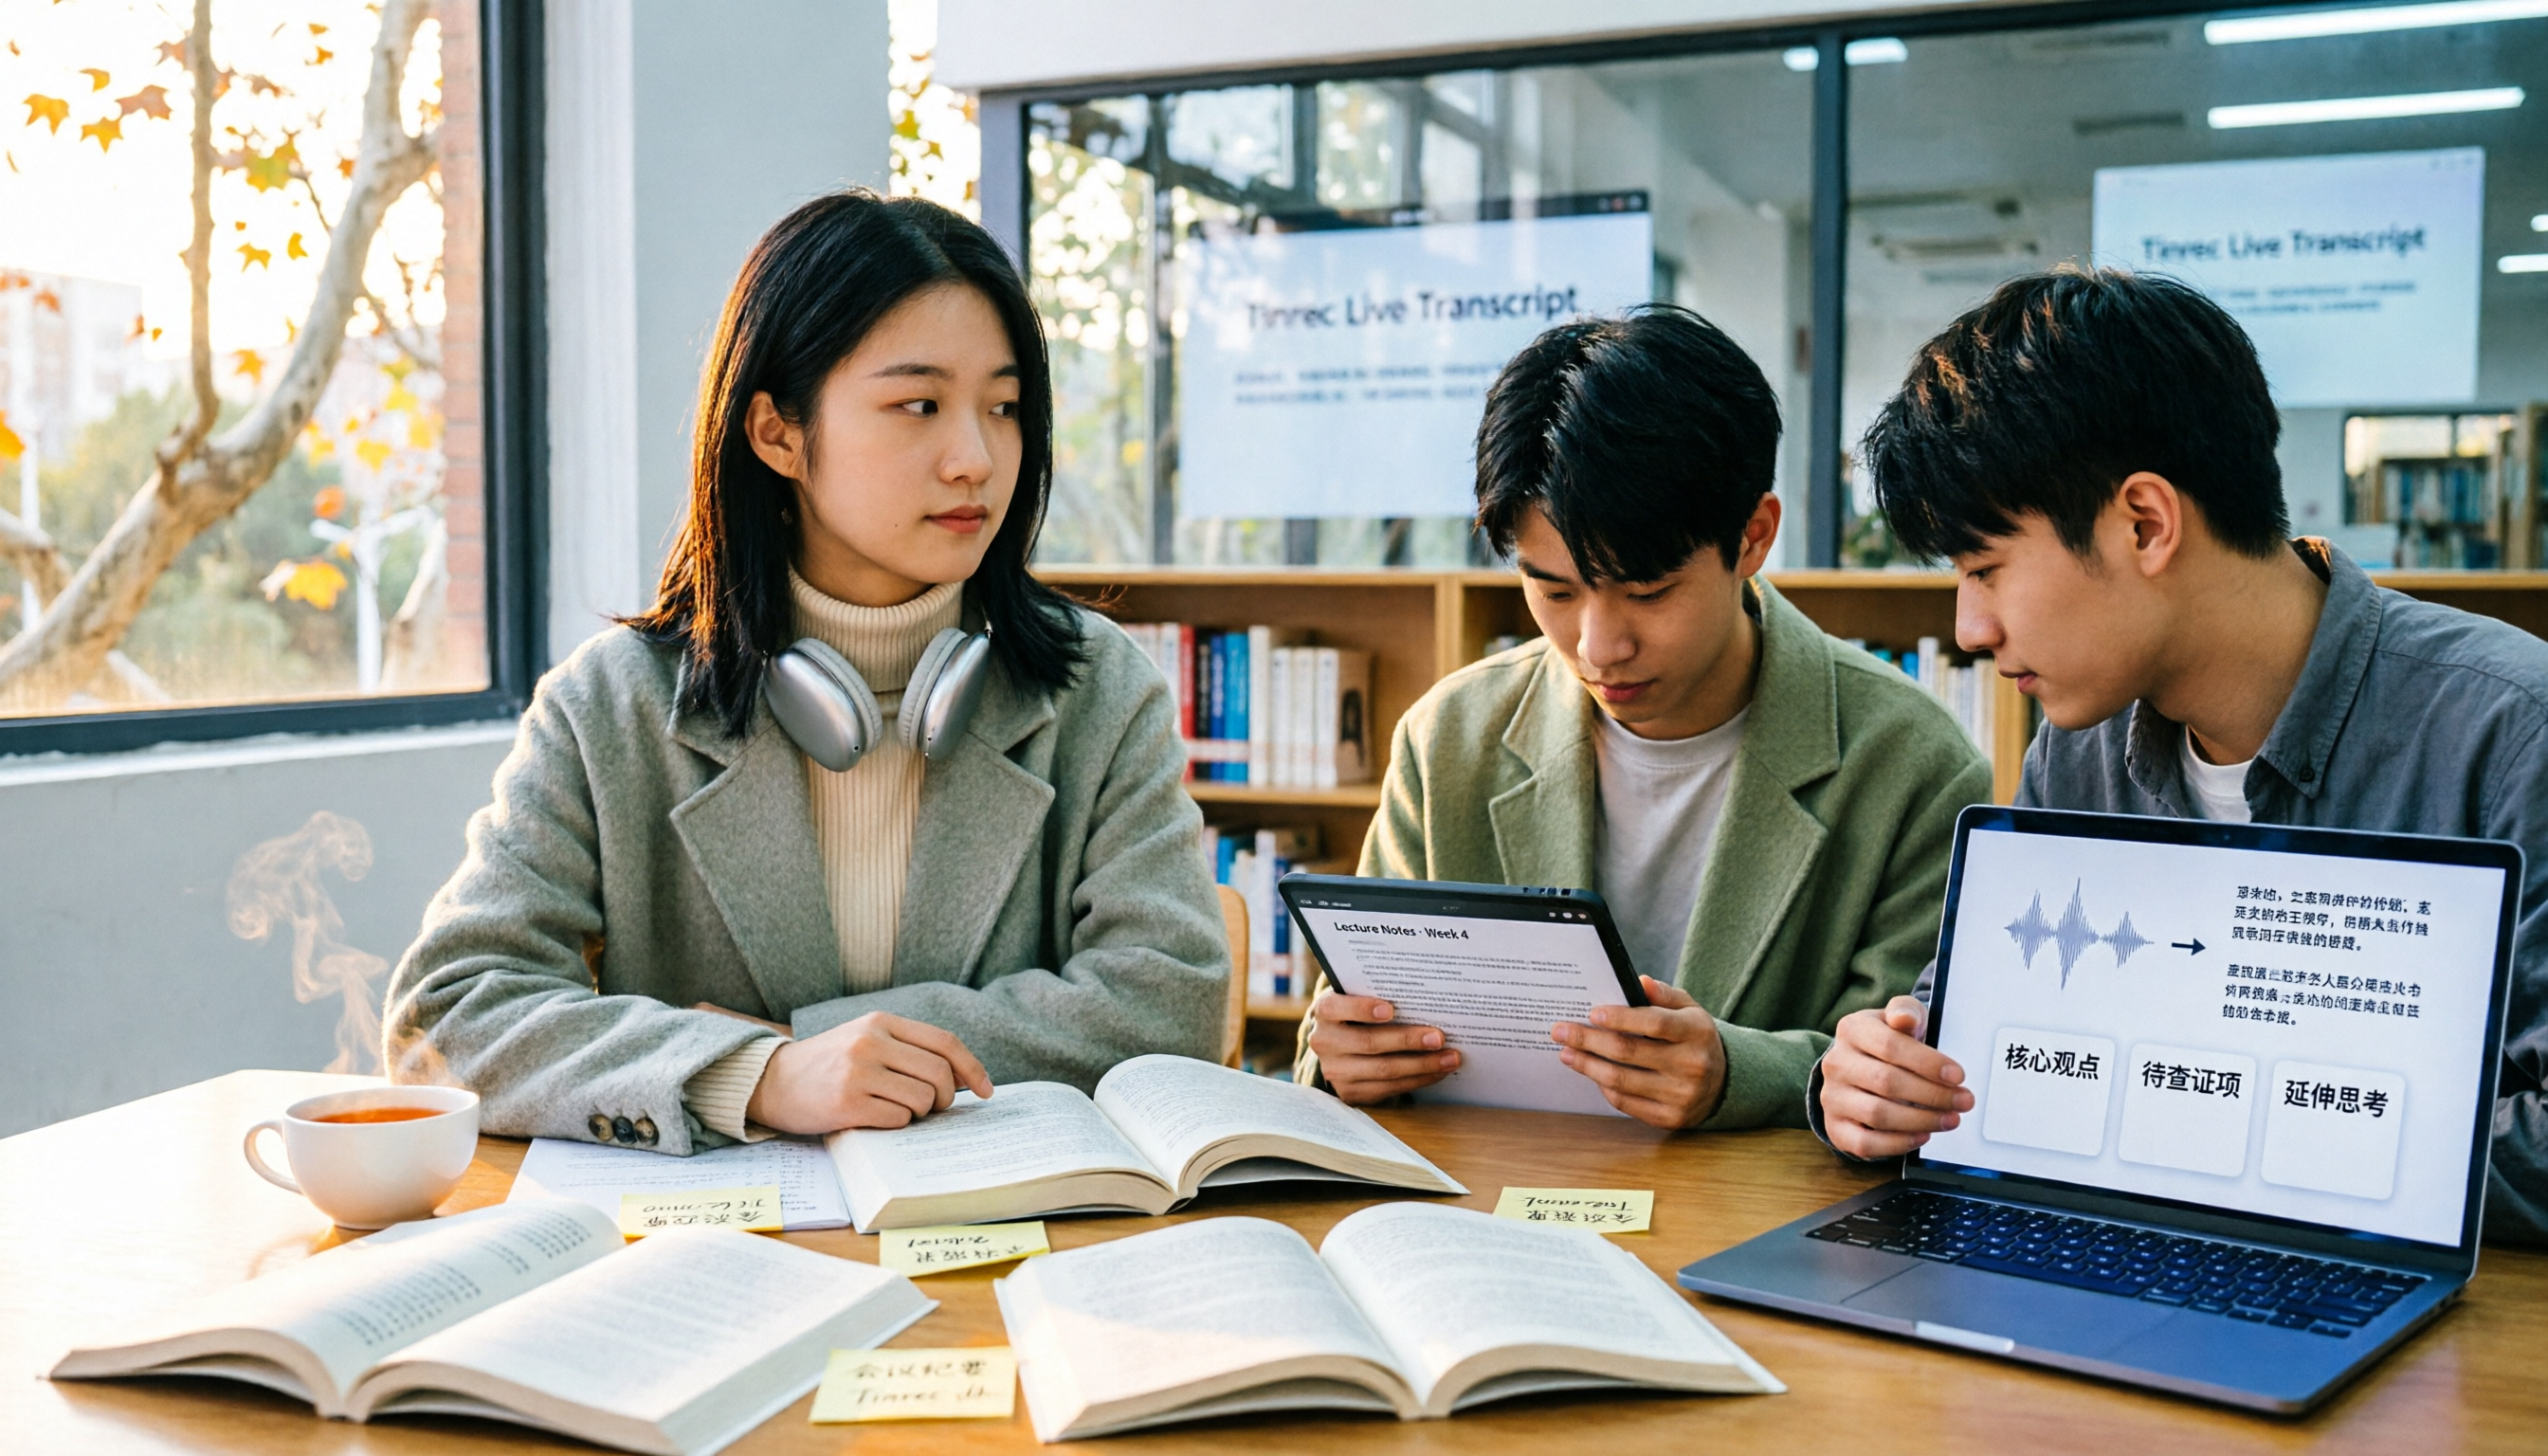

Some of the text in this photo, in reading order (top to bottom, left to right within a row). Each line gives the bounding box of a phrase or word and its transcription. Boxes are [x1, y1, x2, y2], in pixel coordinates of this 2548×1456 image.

[2229, 232, 2280, 259] Live
[2290, 225, 2426, 259] Transcript
[1346, 293, 1408, 325] Live
[1417, 284, 1577, 321] Transcript
[1333, 921, 1379, 934] Lecture
[1380, 924, 1417, 937] Notes
[1424, 927, 1460, 939] Week
[1461, 929, 1469, 939] 4
[2005, 1043, 2101, 1081] 核心观点
[2141, 1060, 2243, 1099] 待查证项
[2284, 1079, 2389, 1119] 延伸思考
